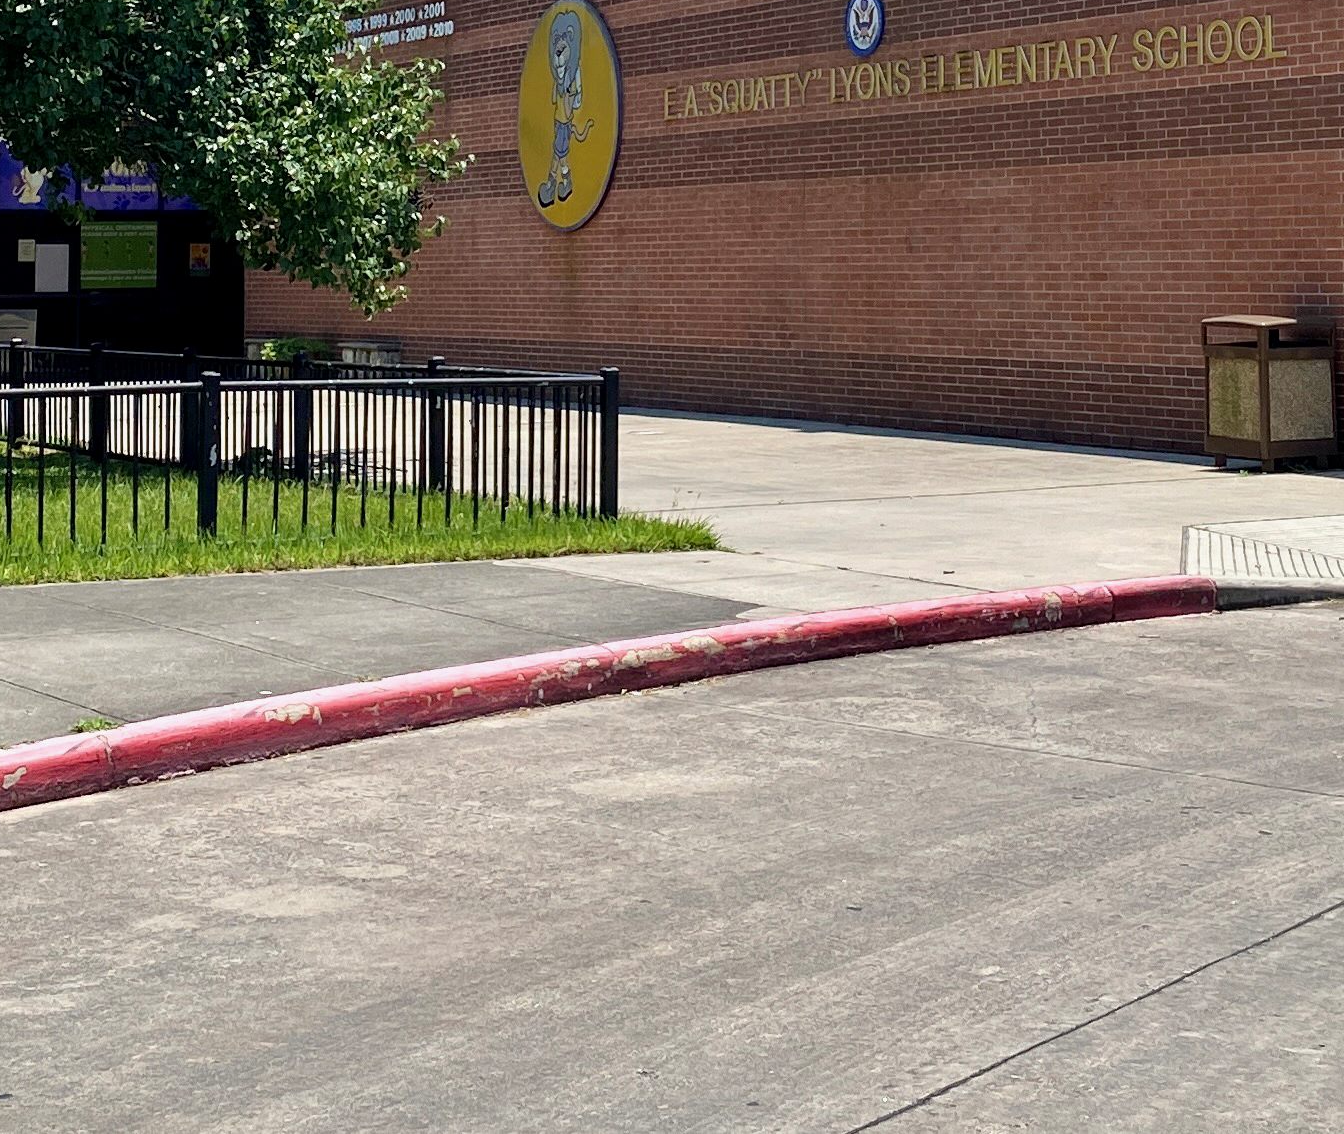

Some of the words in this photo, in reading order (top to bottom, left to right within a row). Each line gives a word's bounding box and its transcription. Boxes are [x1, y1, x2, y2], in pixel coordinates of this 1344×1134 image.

[396, 7, 416, 25] 2000
[424, 1, 445, 20] 2001
[406, 25, 427, 42] 2009
[434, 20, 454, 38] 2010
[830, 60, 911, 103] LYONS
[920, 33, 1118, 95] ELEMENTARY
[1131, 14, 1287, 72] SCHOOL
